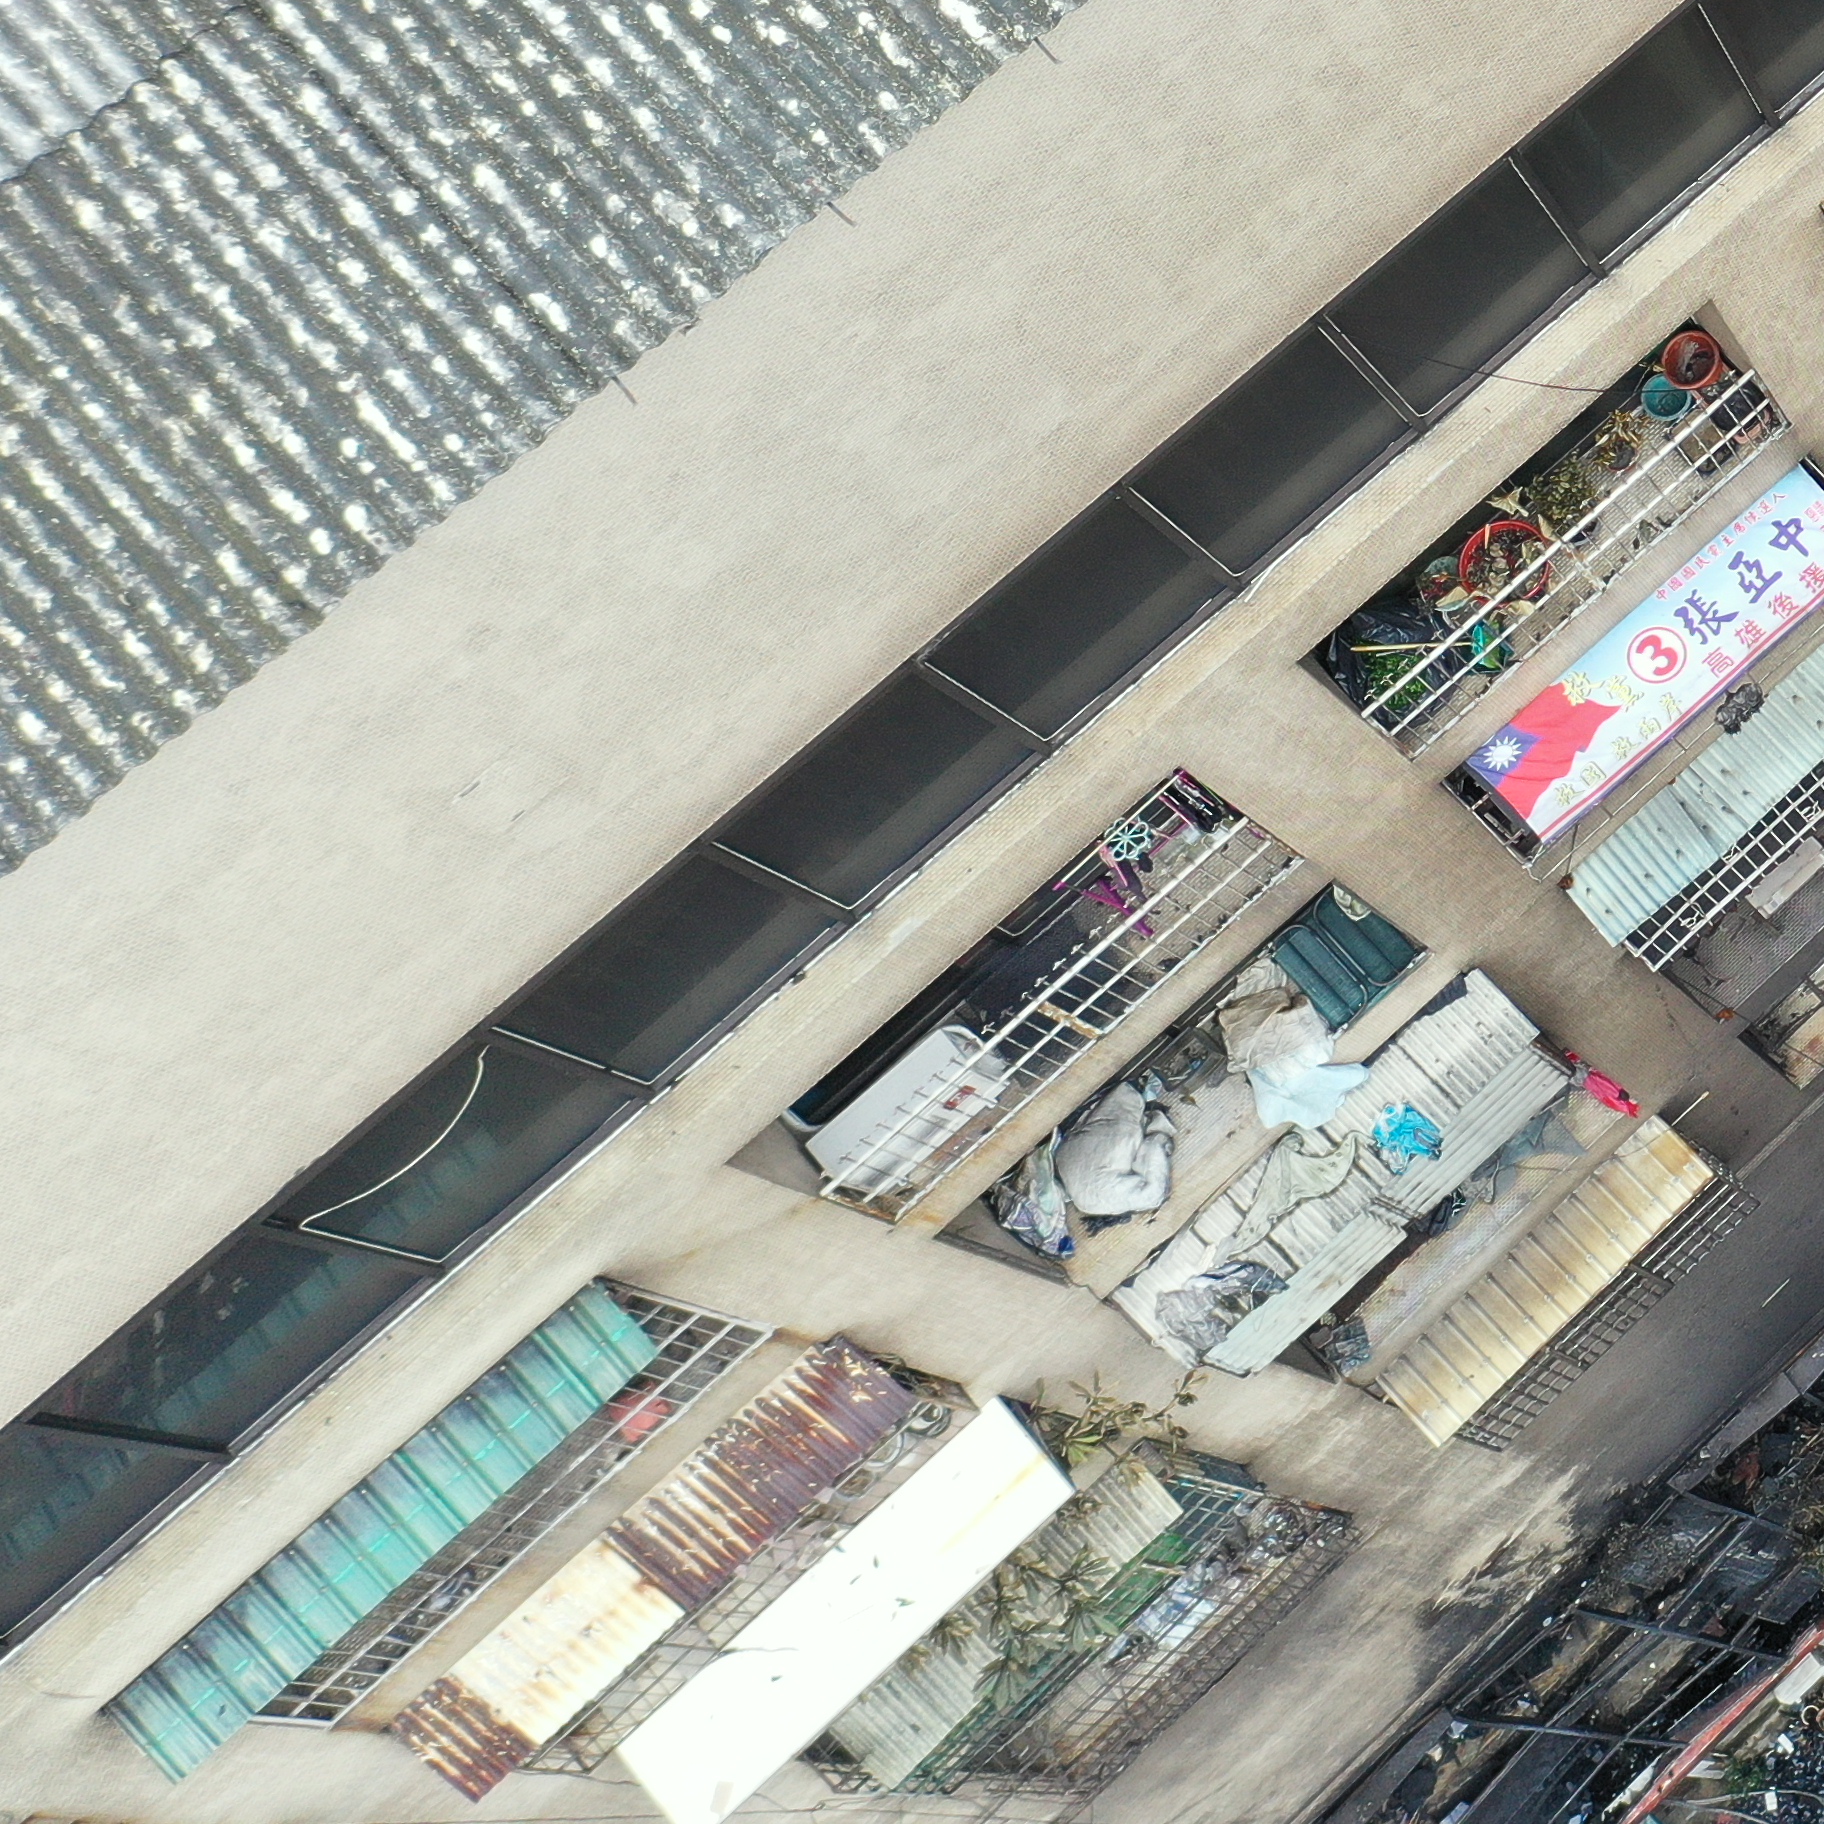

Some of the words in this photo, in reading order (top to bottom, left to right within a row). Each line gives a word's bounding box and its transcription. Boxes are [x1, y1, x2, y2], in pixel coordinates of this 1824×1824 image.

[1673, 516, 1811, 646] 張亞中
[1561, 671, 1646, 714] 救黨
